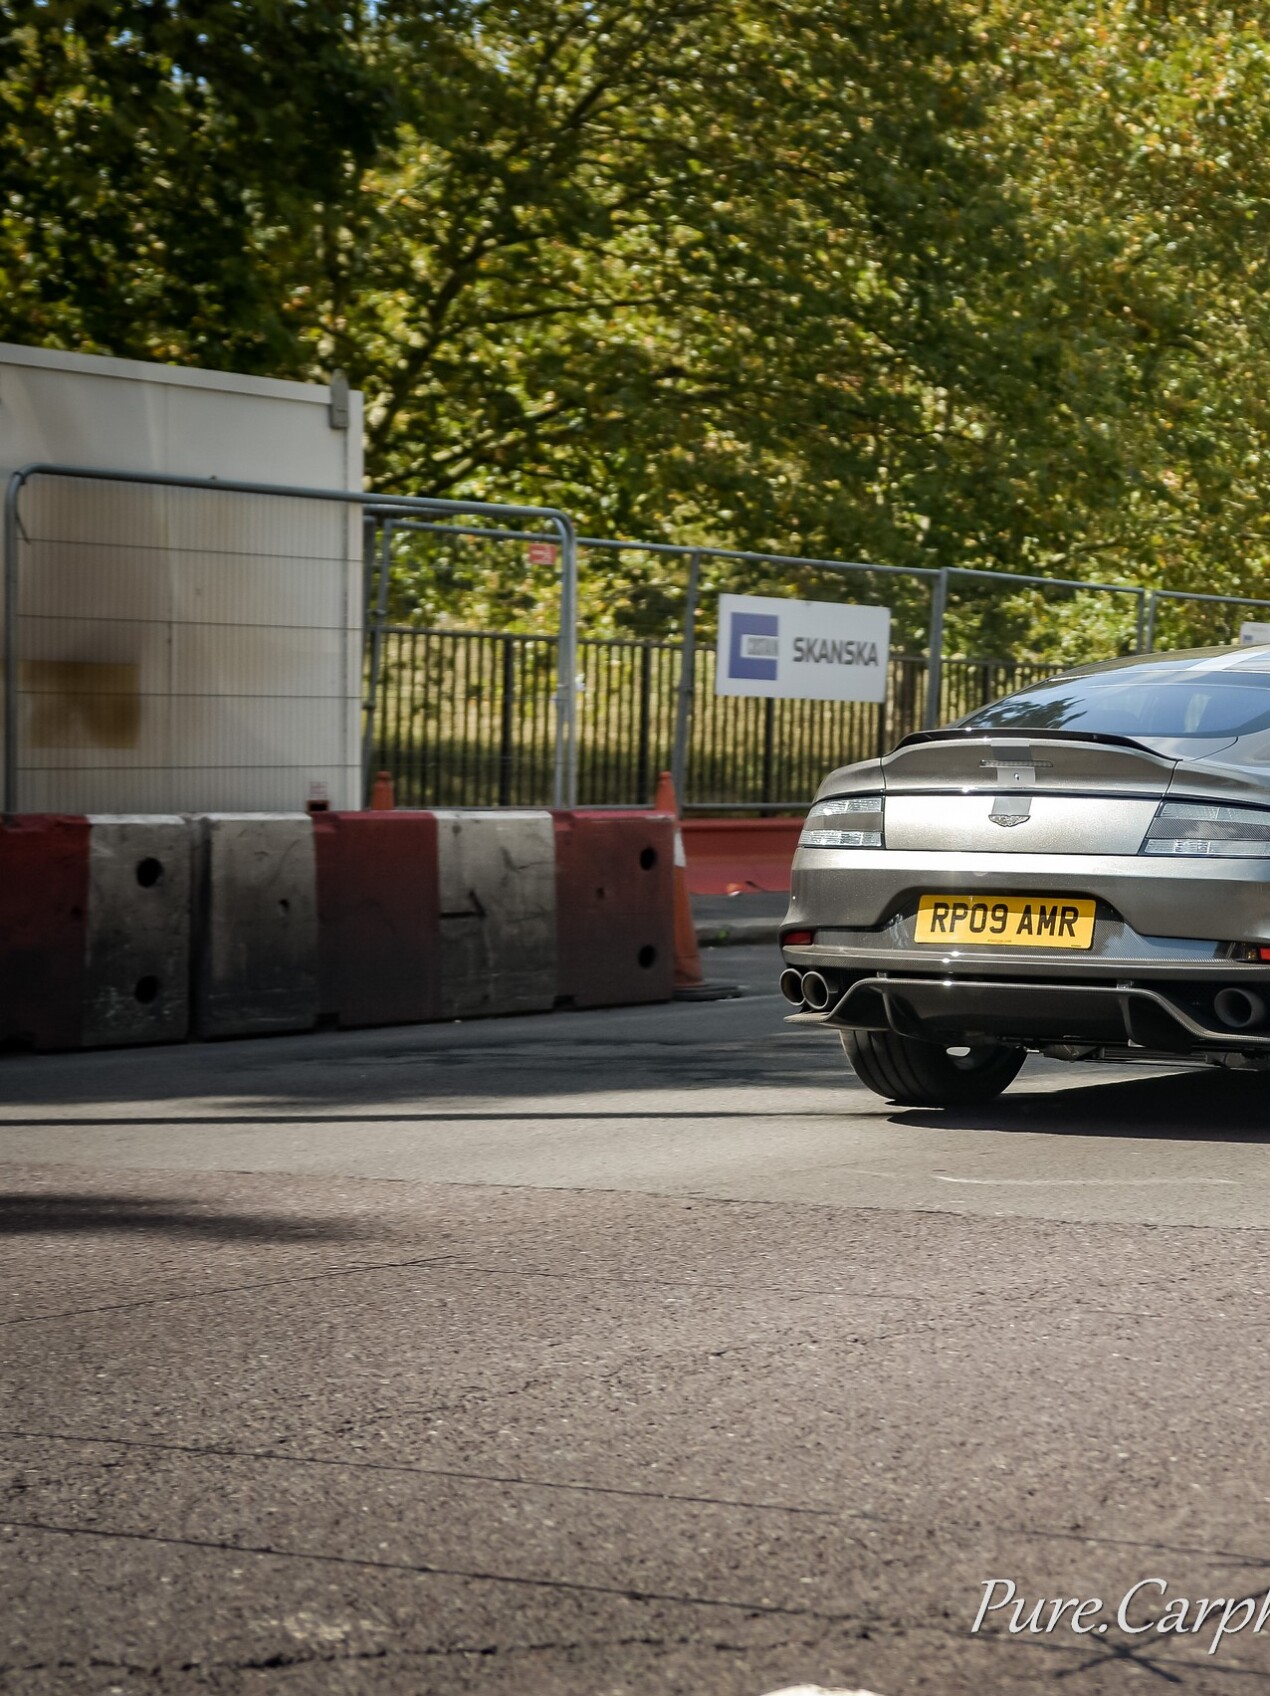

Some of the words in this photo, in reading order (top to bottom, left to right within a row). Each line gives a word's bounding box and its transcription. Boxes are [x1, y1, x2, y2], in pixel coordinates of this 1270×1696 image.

[793, 636, 879, 667] SKANSKA
[930, 901, 1009, 935] RP09
[1016, 904, 1079, 938] AMR
